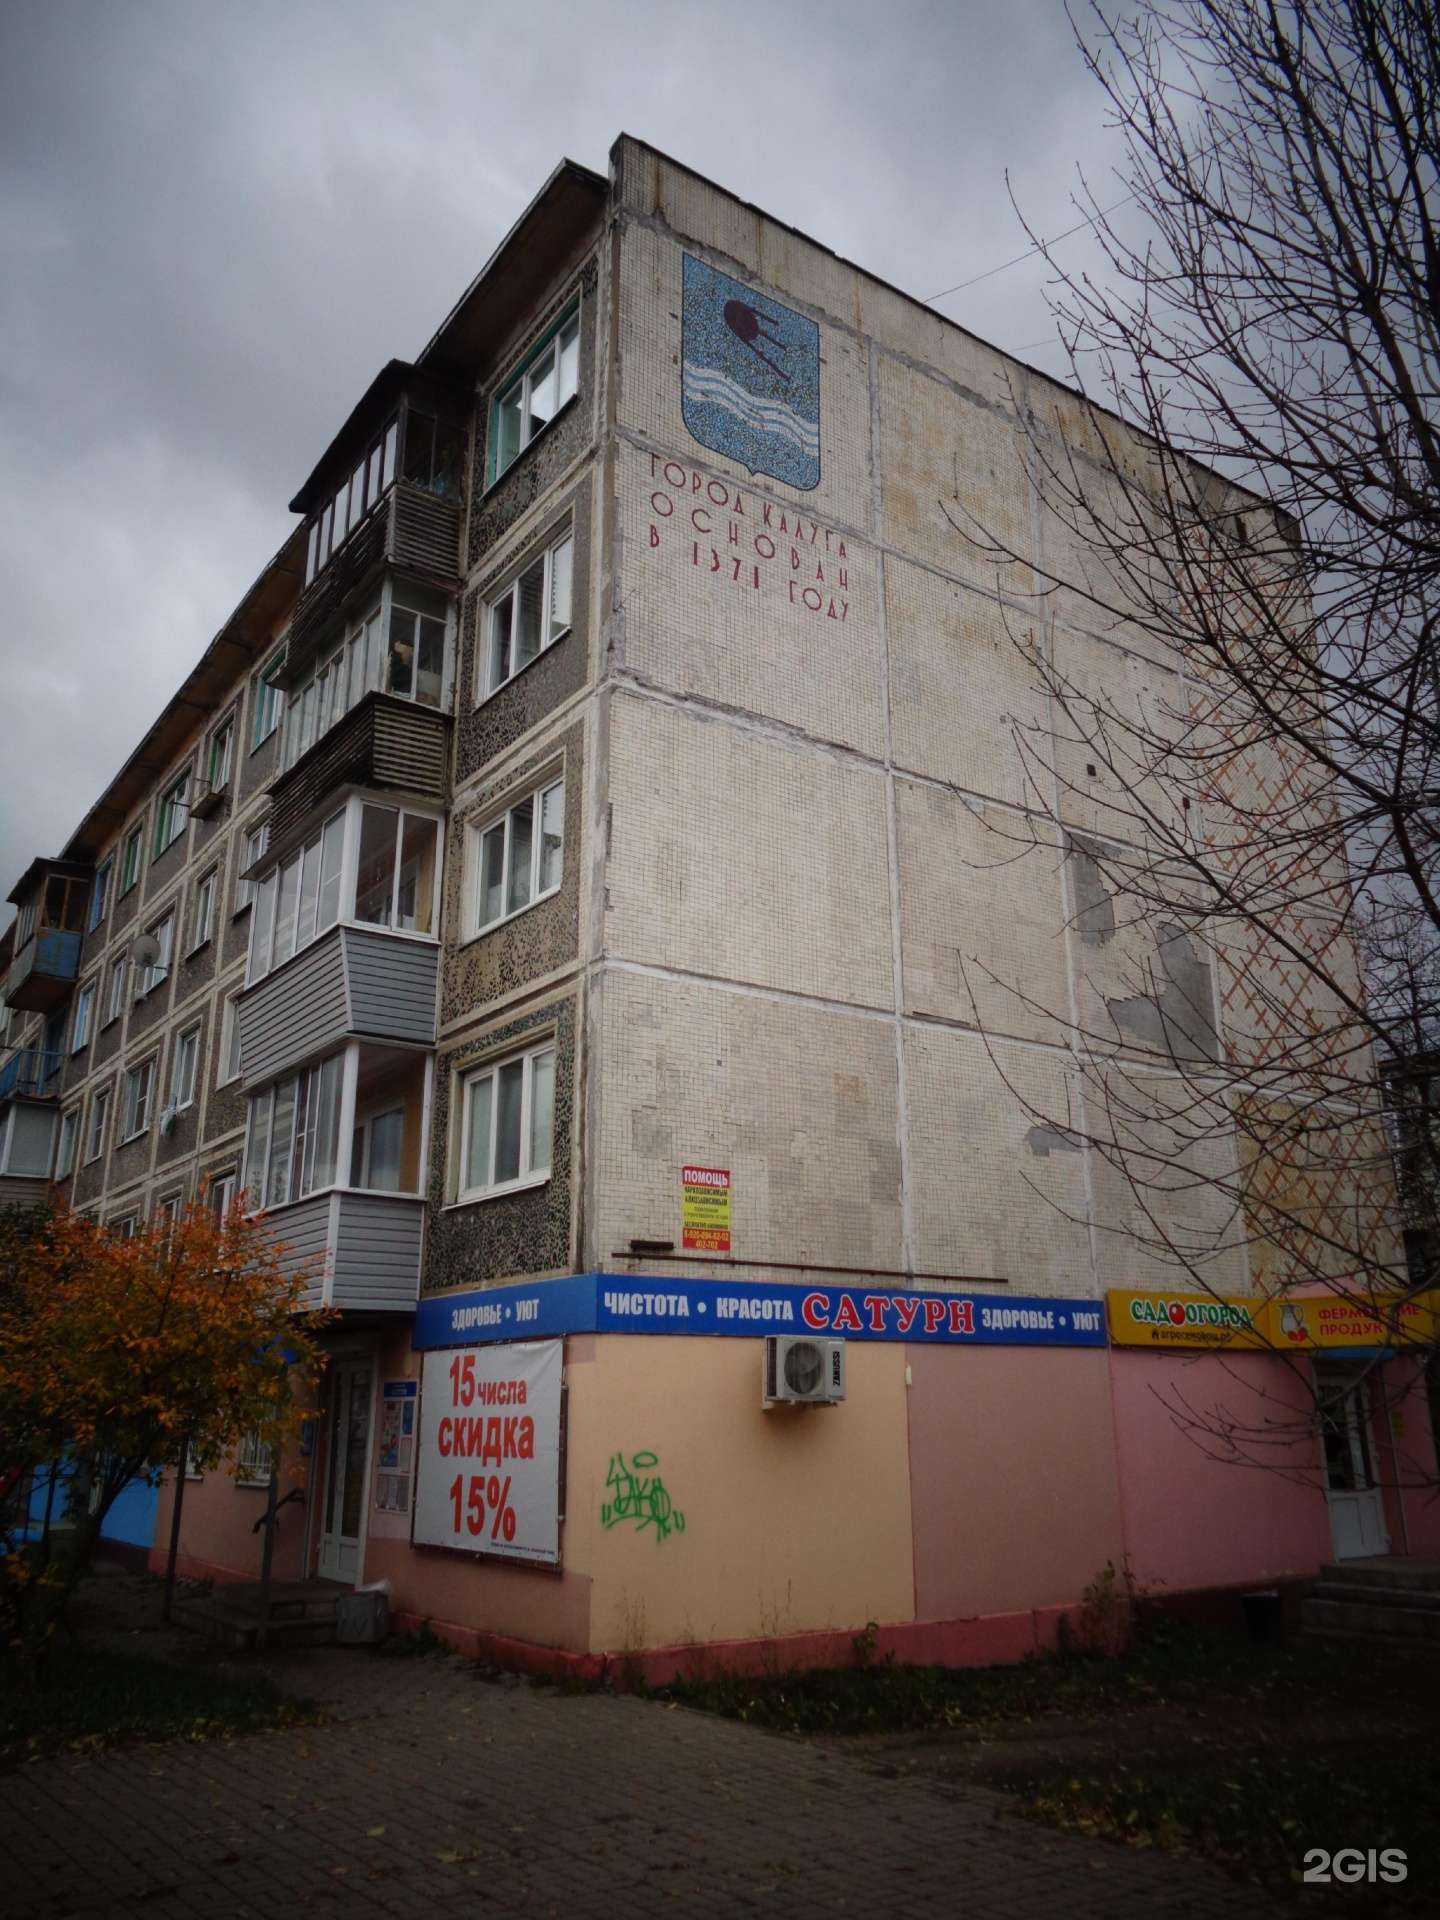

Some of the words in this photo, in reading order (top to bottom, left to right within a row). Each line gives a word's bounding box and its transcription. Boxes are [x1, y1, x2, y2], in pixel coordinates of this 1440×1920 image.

[651, 452, 744, 515] ГОРОД
[761, 502, 847, 558] КАЛУГА
[651, 491, 848, 591] ОСНОВАН
[650, 524, 660, 548] В
[693, 541, 760, 589] 1371
[789, 580, 849, 622] ГОДУ
[684, 1169, 728, 1187] ПОМОЩЬ
[451, 1303, 502, 1331] ЗДОРОВЬЕ
[515, 1300, 539, 1323] УЮТ
[604, 1292, 690, 1317] ЧИСТОТА
[716, 1297, 793, 1320] КРАСОТА
[802, 1293, 976, 1333] САТУРН
[982, 1307, 1055, 1331] ЗДОРОВЬЕ
[1072, 1312, 1100, 1330] УЮТ
[450, 1355, 476, 1407] 15
[477, 1380, 527, 1406] числа
[832, 1351, 841, 1387] ZANUSSI
[438, 1415, 535, 1468] скидка
[450, 1474, 517, 1542] 15%
